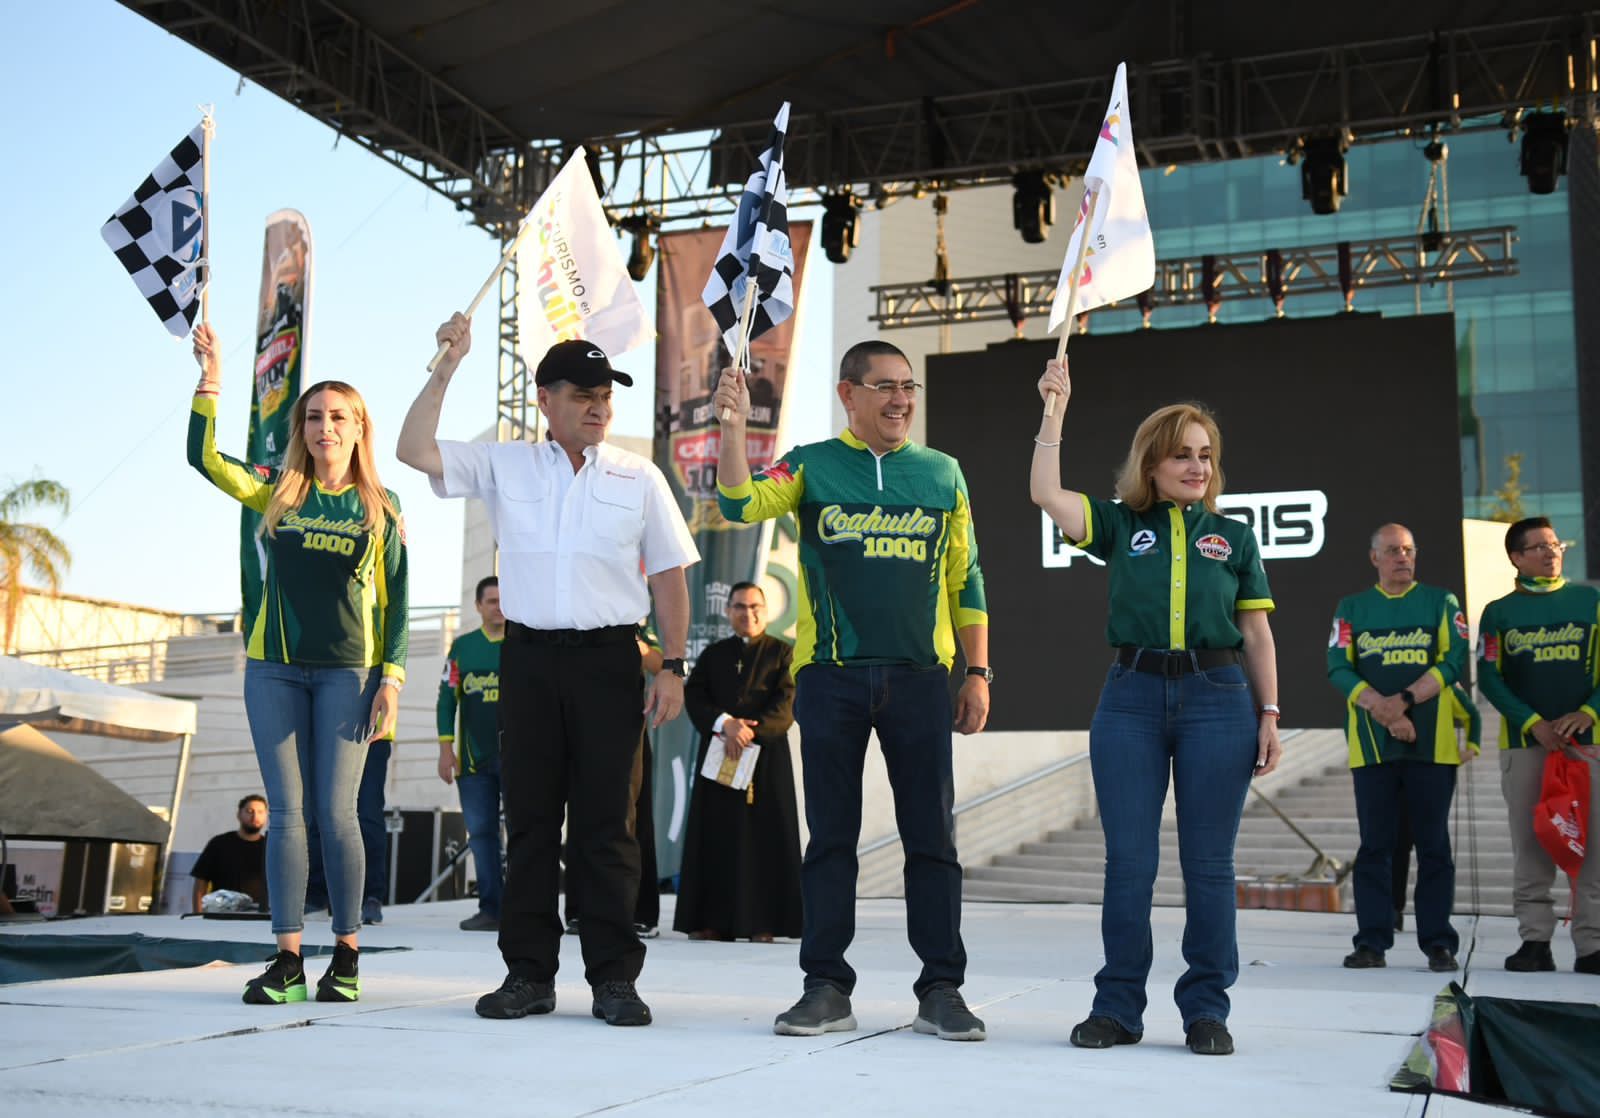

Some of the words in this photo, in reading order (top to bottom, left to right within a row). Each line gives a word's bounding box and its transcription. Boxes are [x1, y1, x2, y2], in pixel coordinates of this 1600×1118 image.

[552, 226, 586, 298] URISMO
[580, 301, 591, 315] en
[816, 504, 937, 545] Coahuila
[302, 532, 356, 556] 1000
[863, 536, 927, 562] 1000
[1357, 627, 1432, 659] Coahuila
[1504, 622, 1584, 656] Coahuila
[1382, 649, 1428, 666] 1000
[1533, 644, 1580, 662] 1000
[482, 688, 499, 702] 10
